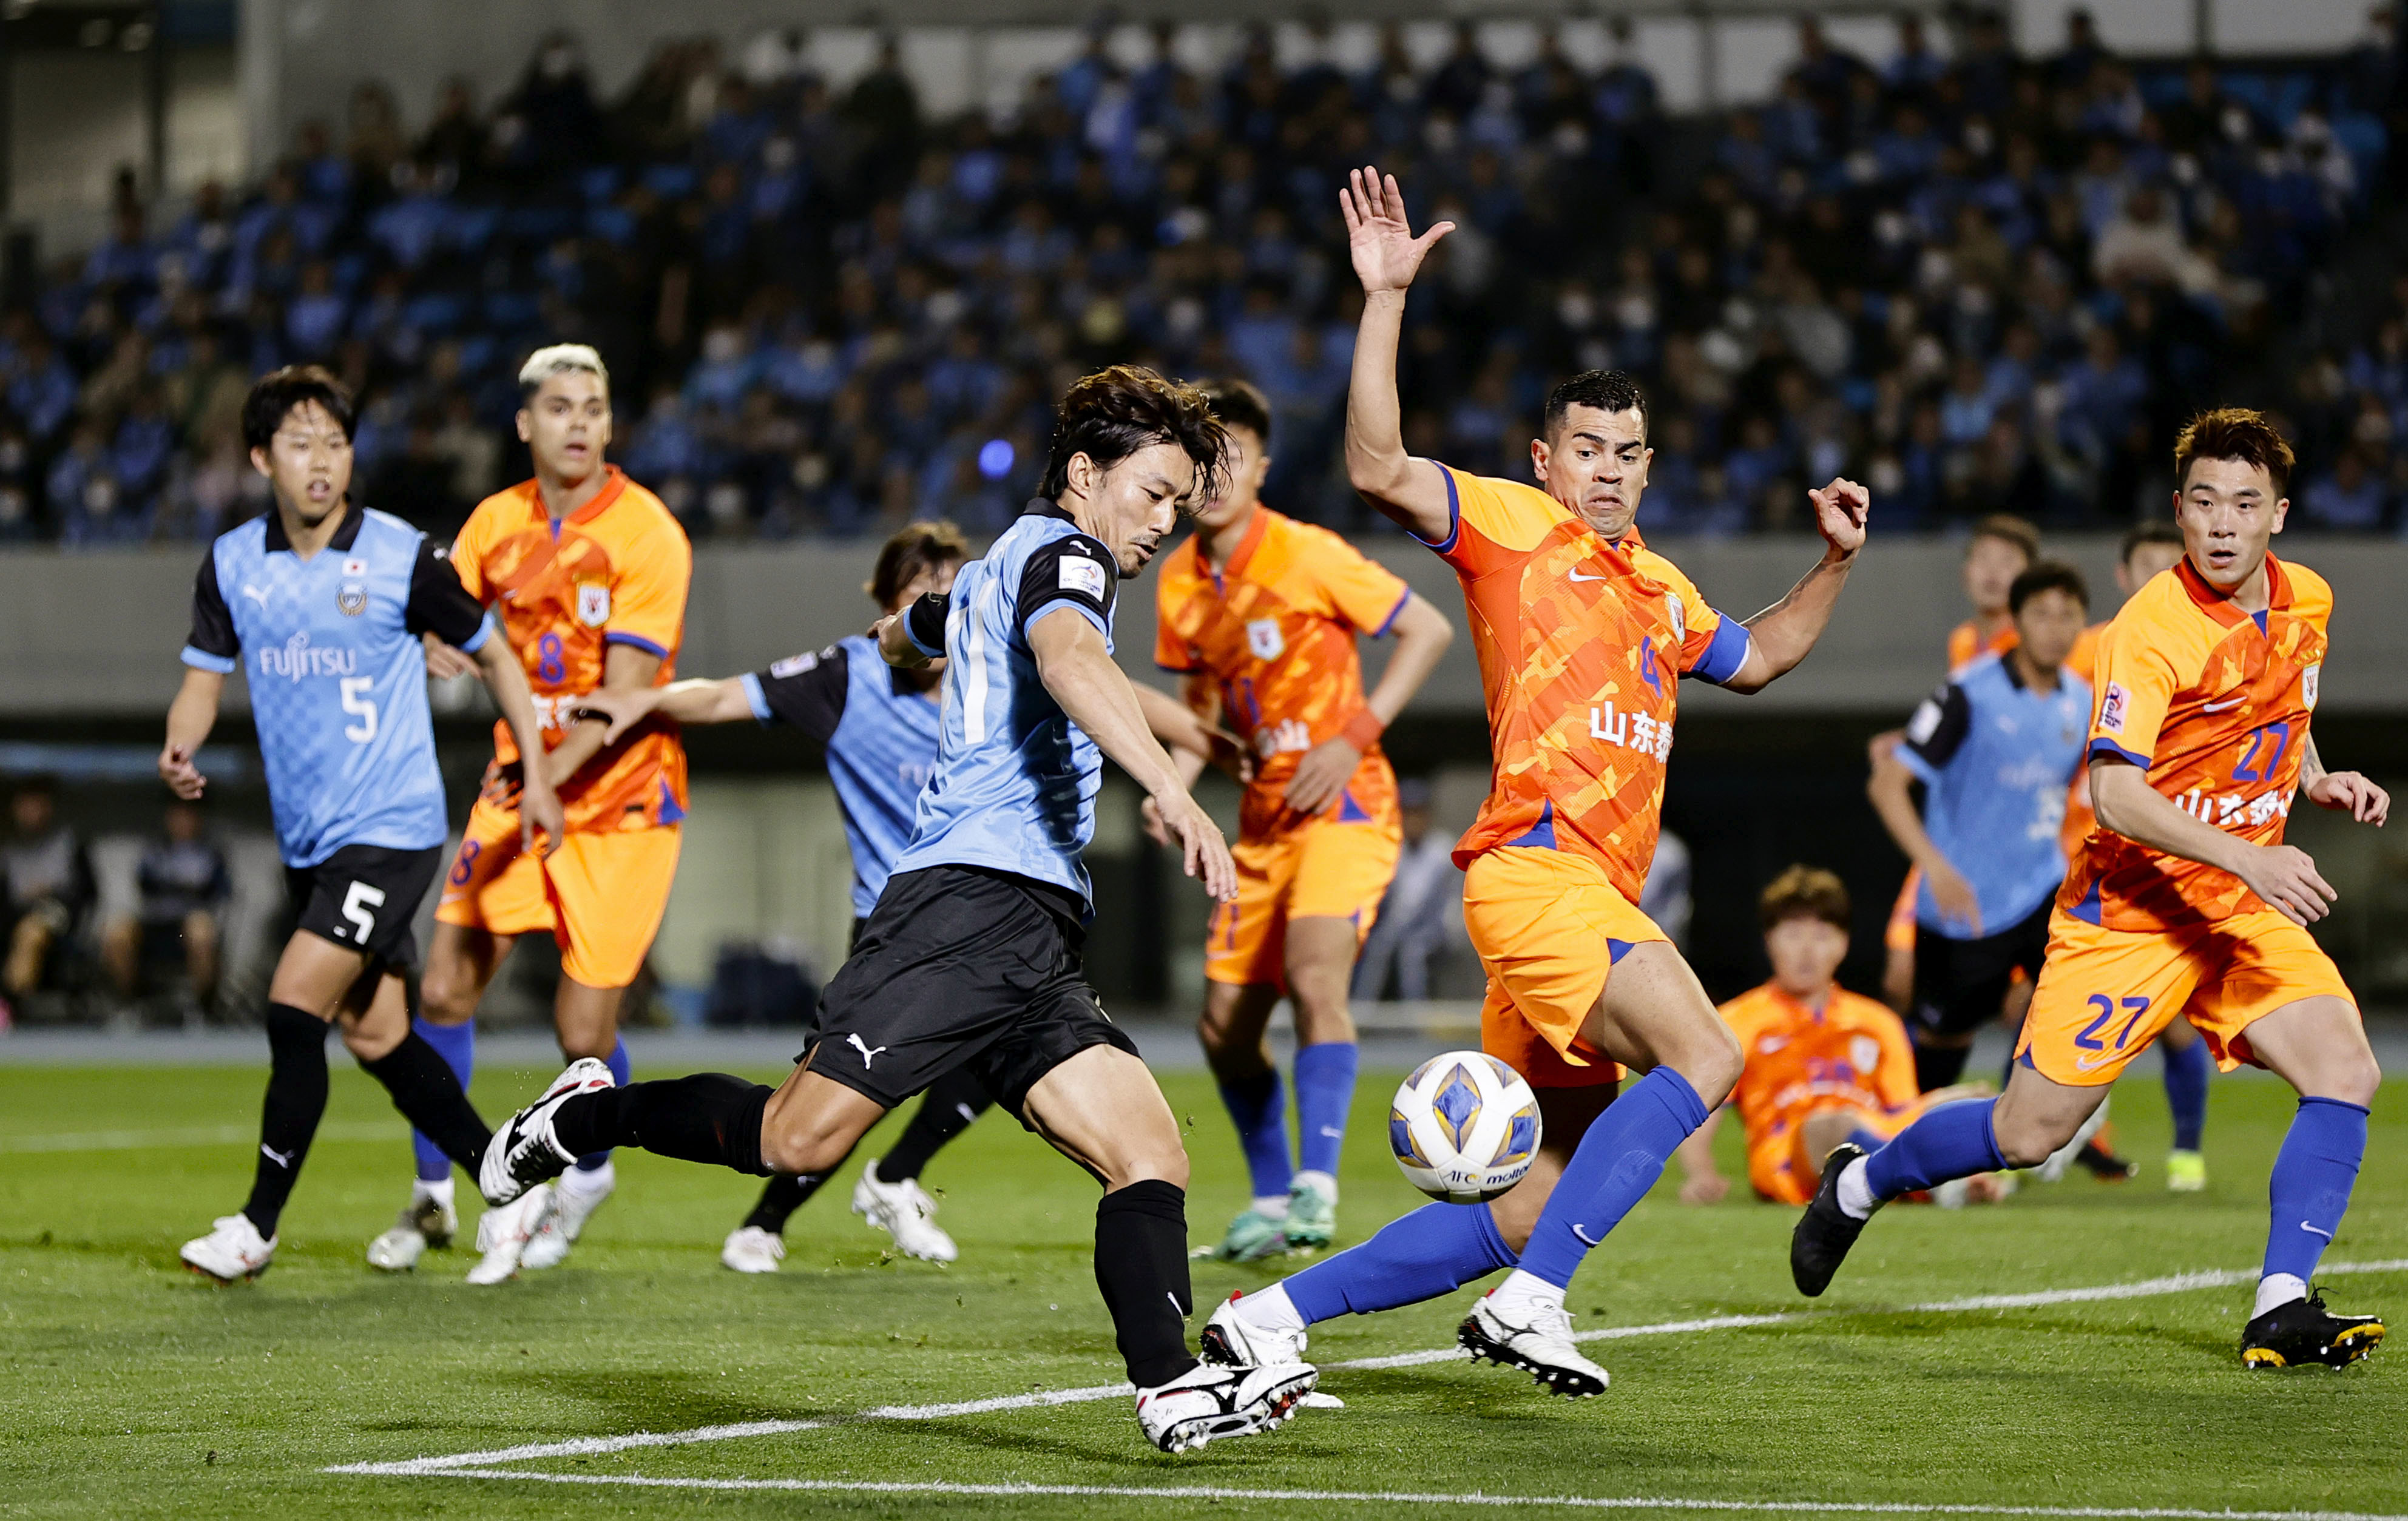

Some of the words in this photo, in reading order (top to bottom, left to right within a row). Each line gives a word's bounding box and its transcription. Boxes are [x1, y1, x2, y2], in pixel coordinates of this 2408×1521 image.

[259, 630, 358, 685] FUJITSU
[539, 632, 566, 685] 8
[1640, 635, 1663, 698] 4
[340, 675, 379, 744] 5
[2231, 722, 2288, 782] 27
[451, 839, 479, 886] 8
[333, 880, 386, 945] 5
[2074, 994, 2150, 1050] 27
[1444, 1170, 1480, 1184] AFC
